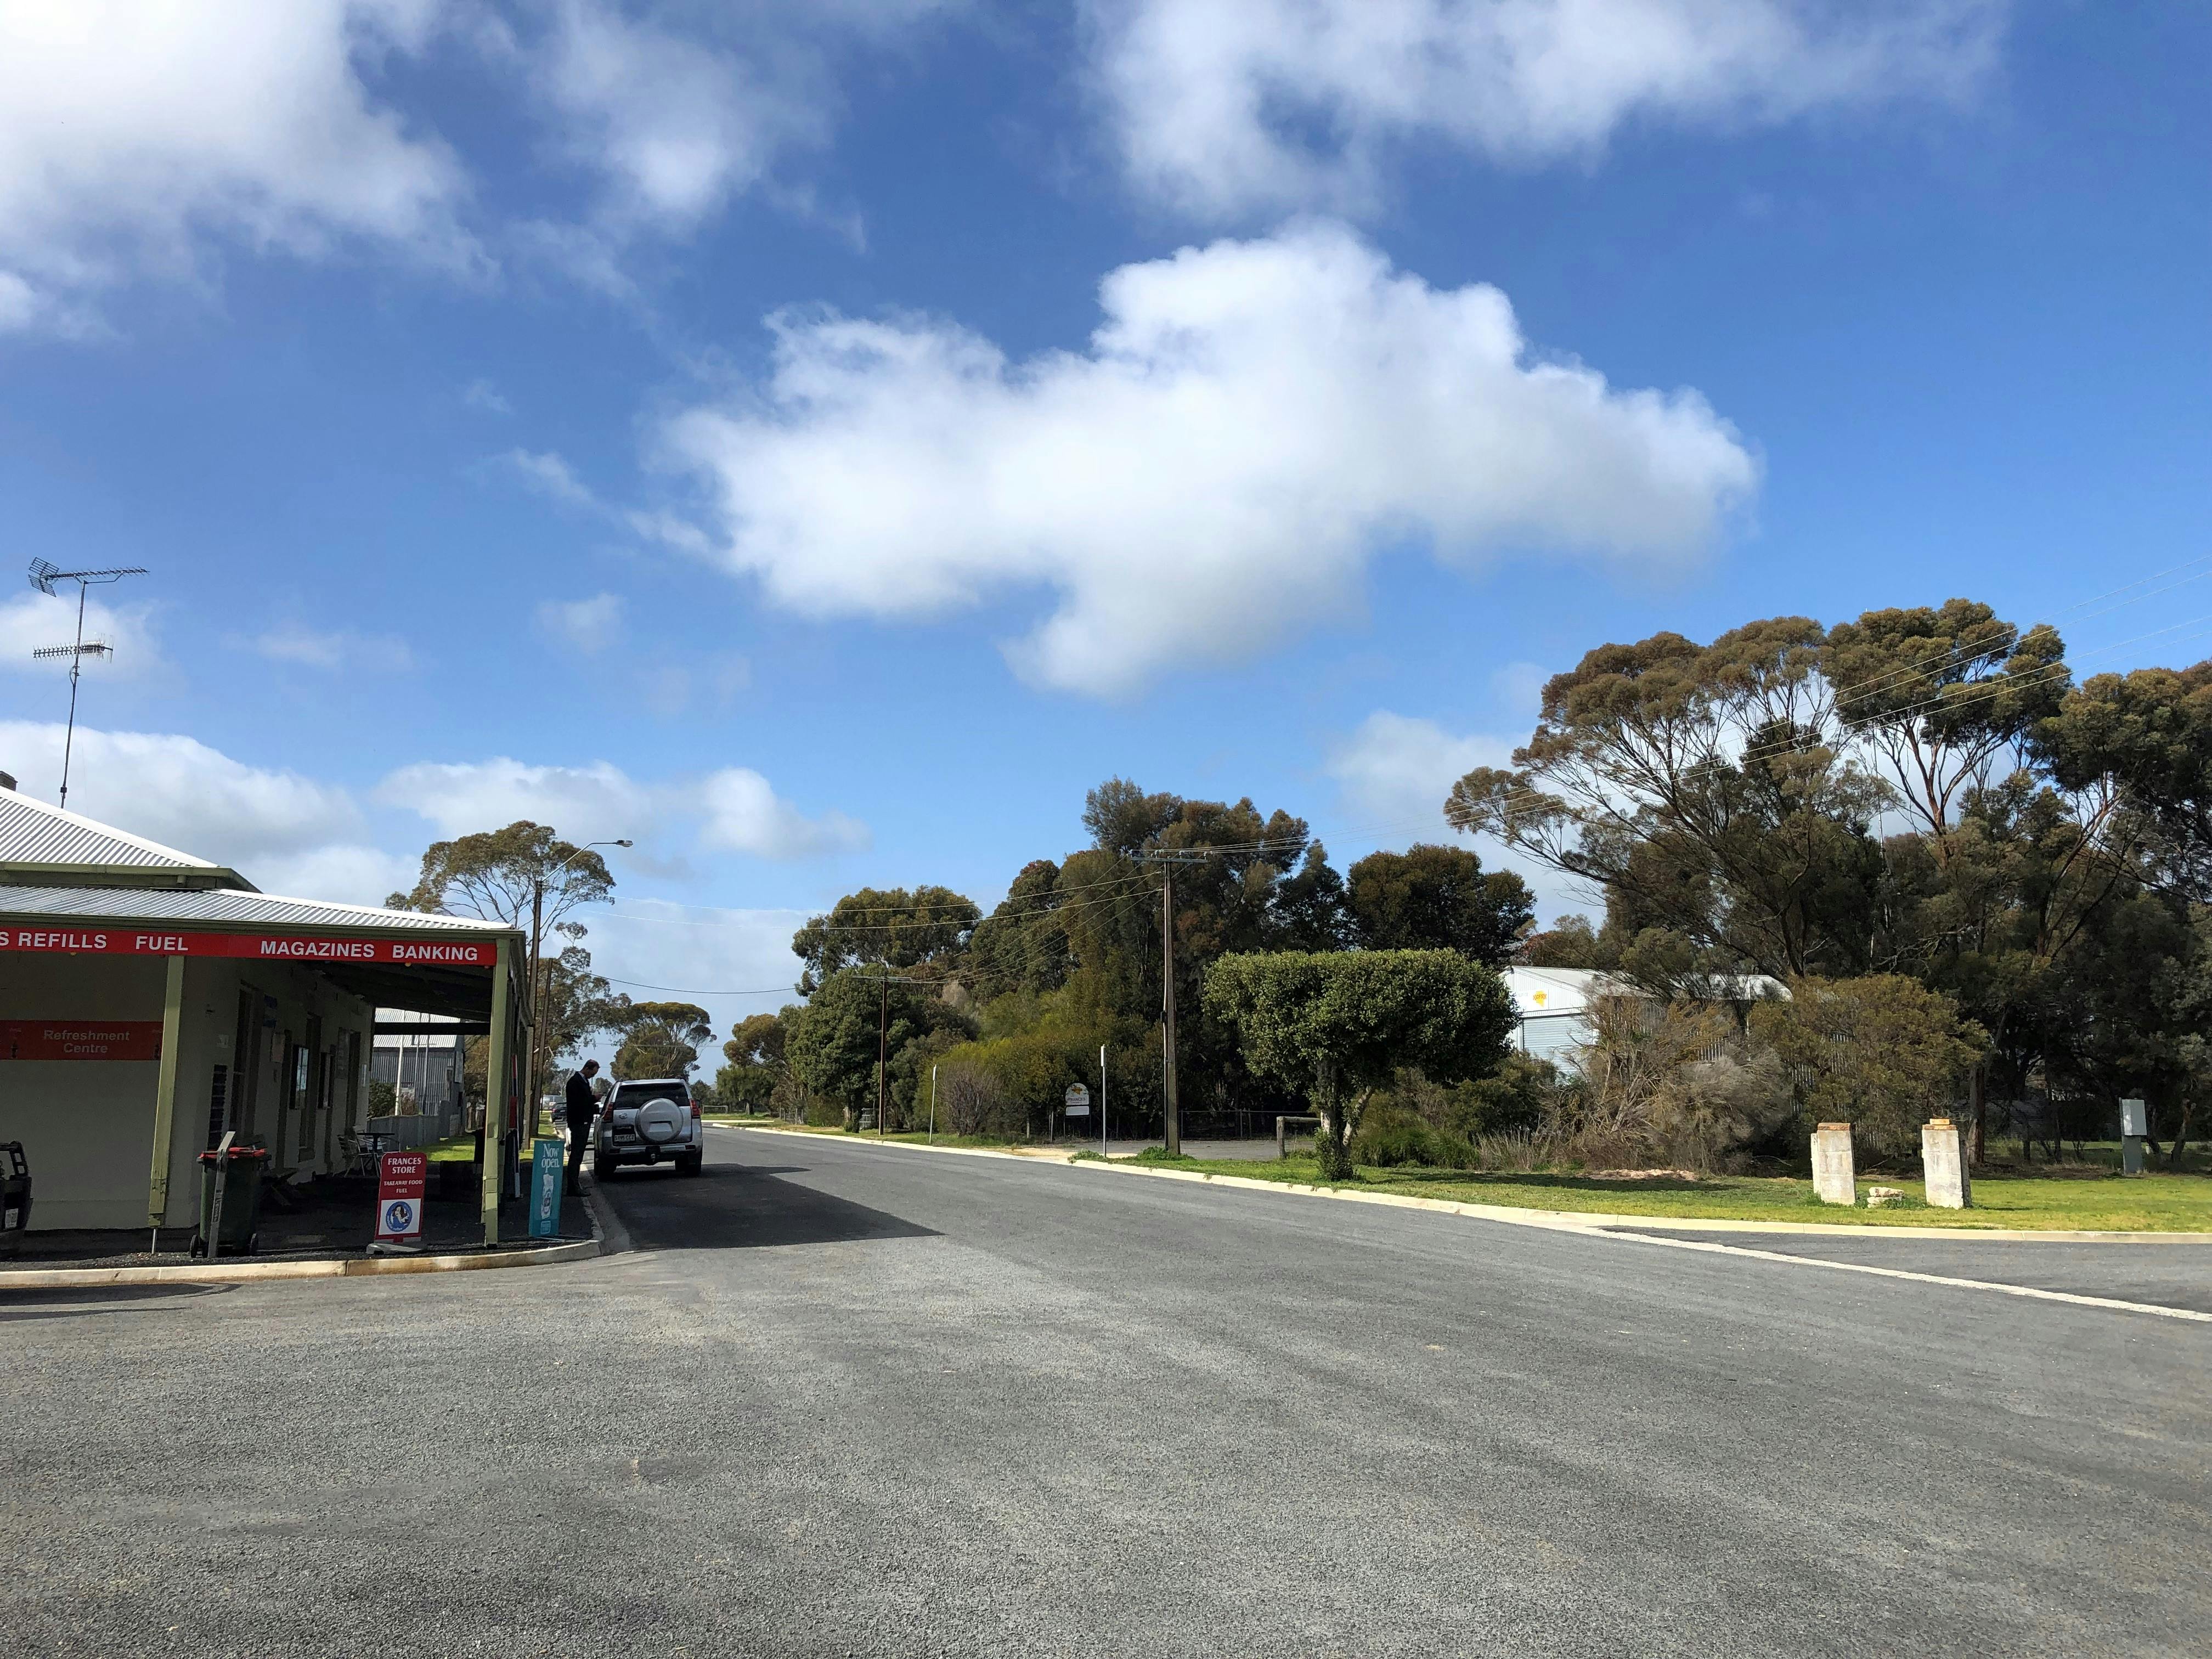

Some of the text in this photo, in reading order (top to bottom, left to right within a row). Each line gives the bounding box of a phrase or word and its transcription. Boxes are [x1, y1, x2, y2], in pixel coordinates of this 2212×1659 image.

[18, 932, 107, 949] REFILLS
[136, 936, 188, 951] FUEL
[261, 940, 374, 957] MAGAZINES
[392, 945, 478, 961] BANKING
[43, 1029, 130, 1041] Refreshment
[64, 1043, 108, 1053] Centre
[543, 1143, 559, 1158] Now
[387, 1157, 422, 1165] FRANCES
[392, 1166, 416, 1174] STORE
